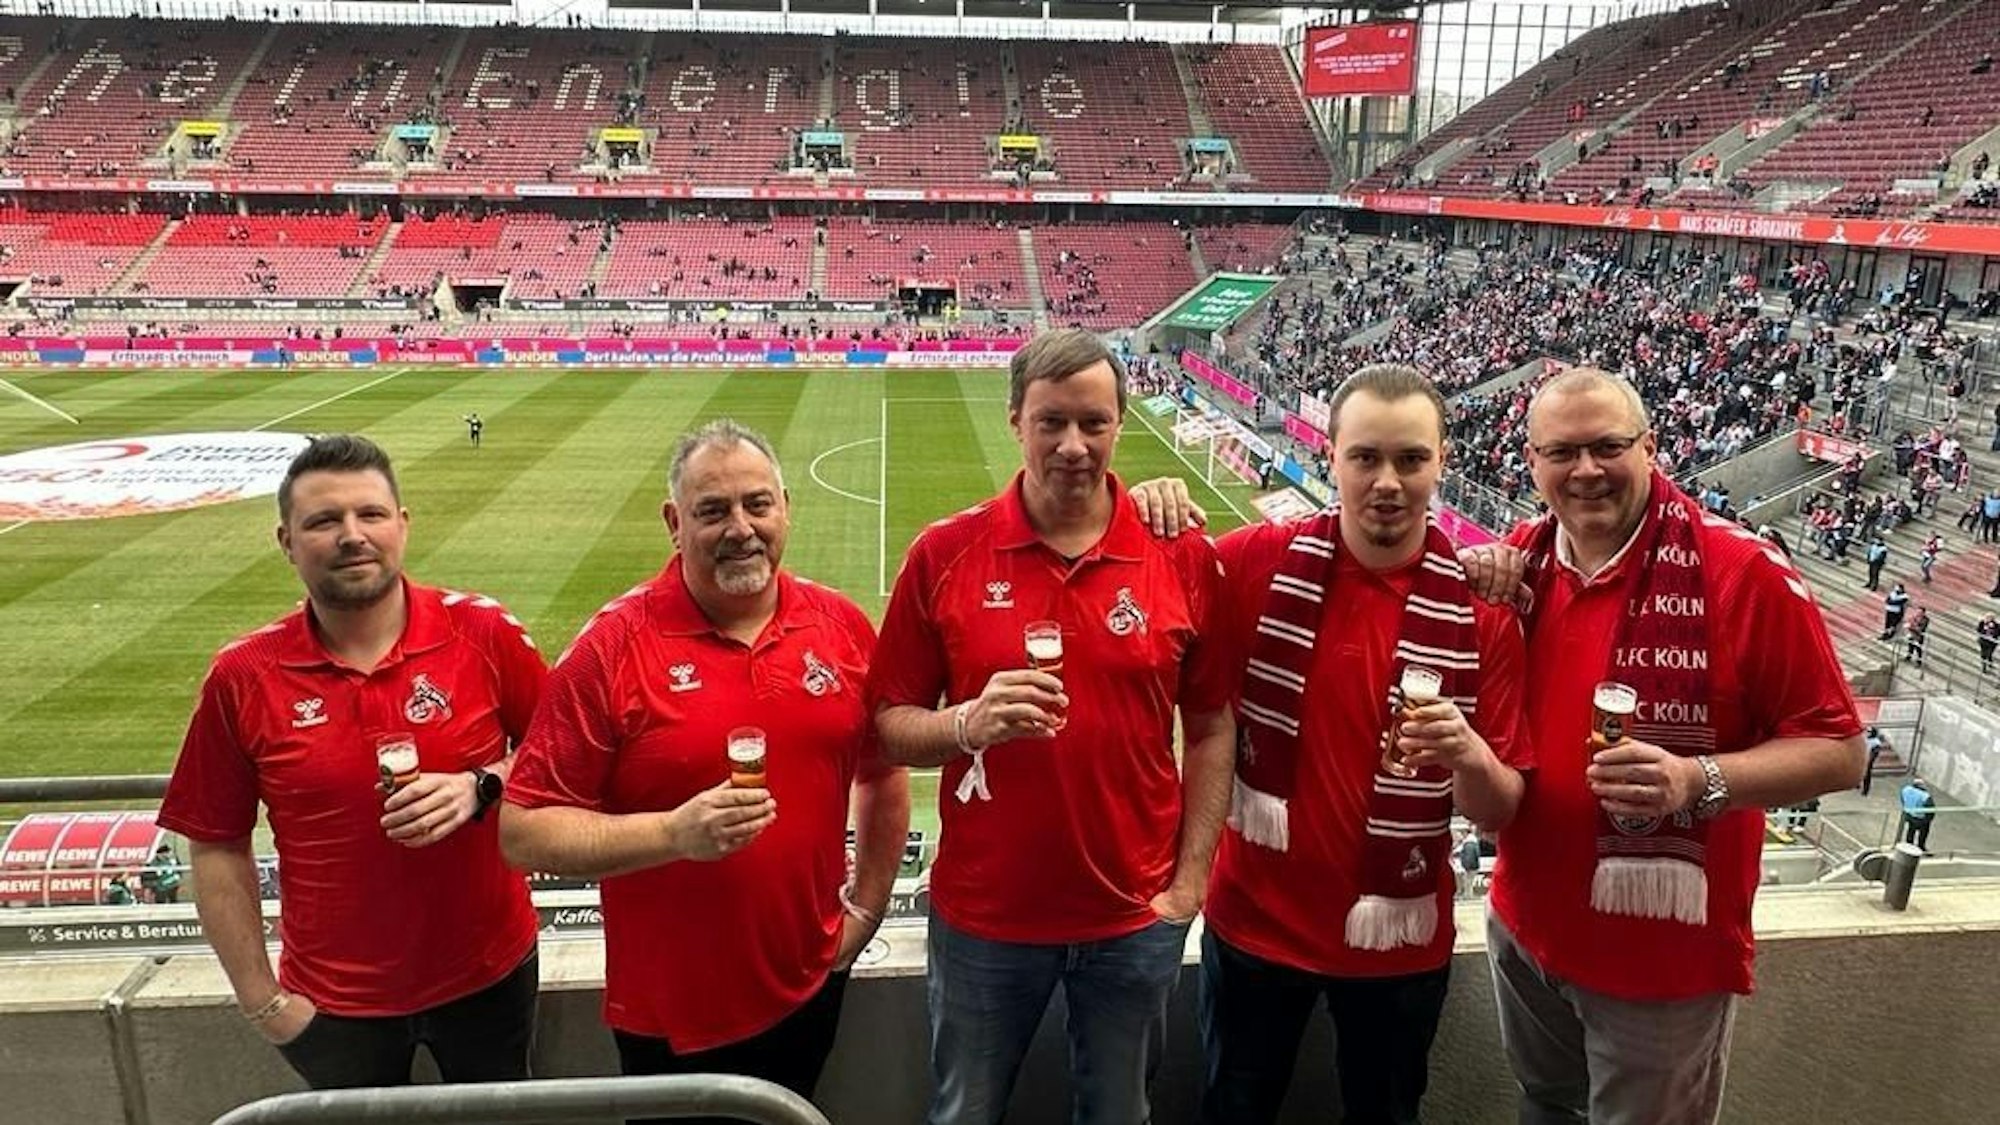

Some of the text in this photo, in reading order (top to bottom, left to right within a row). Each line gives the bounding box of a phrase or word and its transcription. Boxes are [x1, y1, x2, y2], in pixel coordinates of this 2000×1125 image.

[1678, 215, 1703, 232] HANS
[584, 351, 610, 362] Dort
[911, 353, 1009, 362] Erftstadt-Lechenic
[1655, 592, 1705, 616] KÖLN
[1616, 645, 1708, 670] 1.FC KÖLN
[1654, 699, 1708, 724] KÖLN
[4, 849, 46, 863] REWE
[56, 848, 98, 861] REWE
[106, 847, 149, 860] REWE
[50, 878, 92, 892] REWE
[553, 909, 604, 925] Kaffe
[53, 926, 119, 942] Service
[121, 925, 135, 939] &
